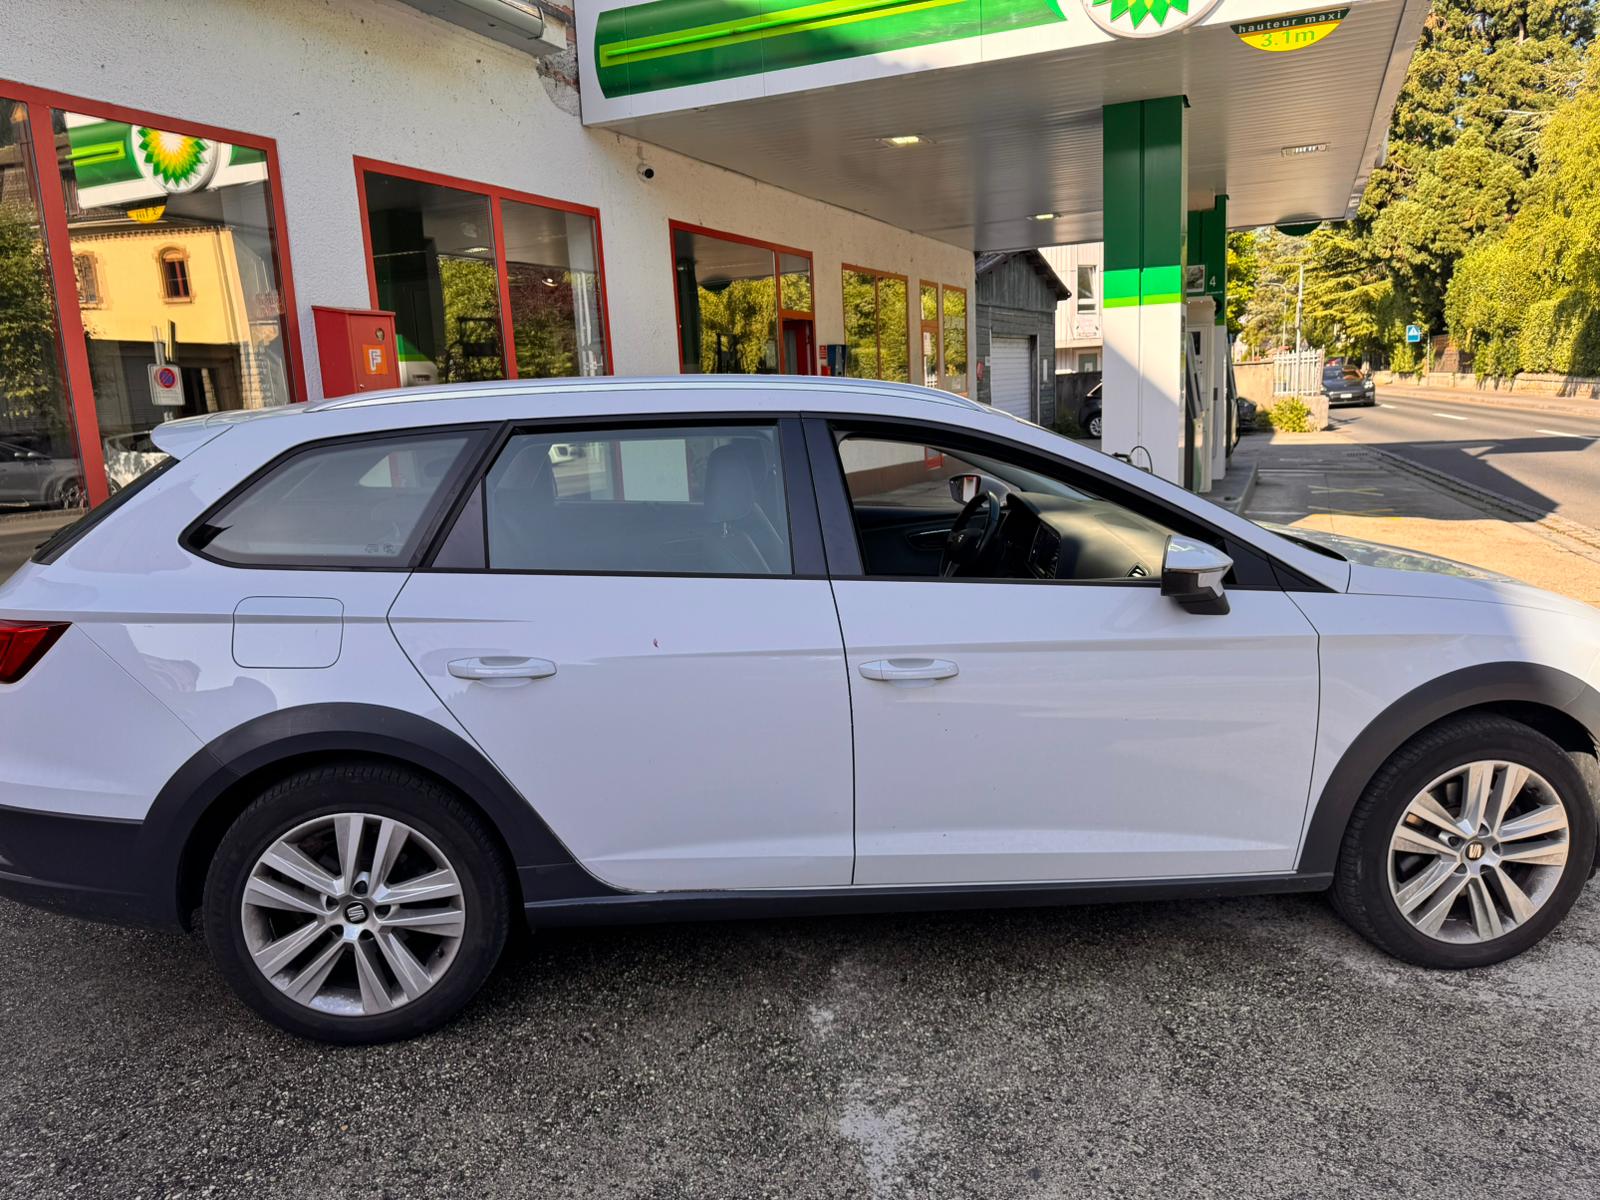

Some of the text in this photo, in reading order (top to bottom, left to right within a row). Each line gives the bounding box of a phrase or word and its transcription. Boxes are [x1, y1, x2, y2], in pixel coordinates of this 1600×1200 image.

[1238, 11, 1342, 33] hauteur maxi
[1261, 30, 1315, 47] 3.1m
[1209, 275, 1216, 287] 4
[368, 349, 382, 372] F
